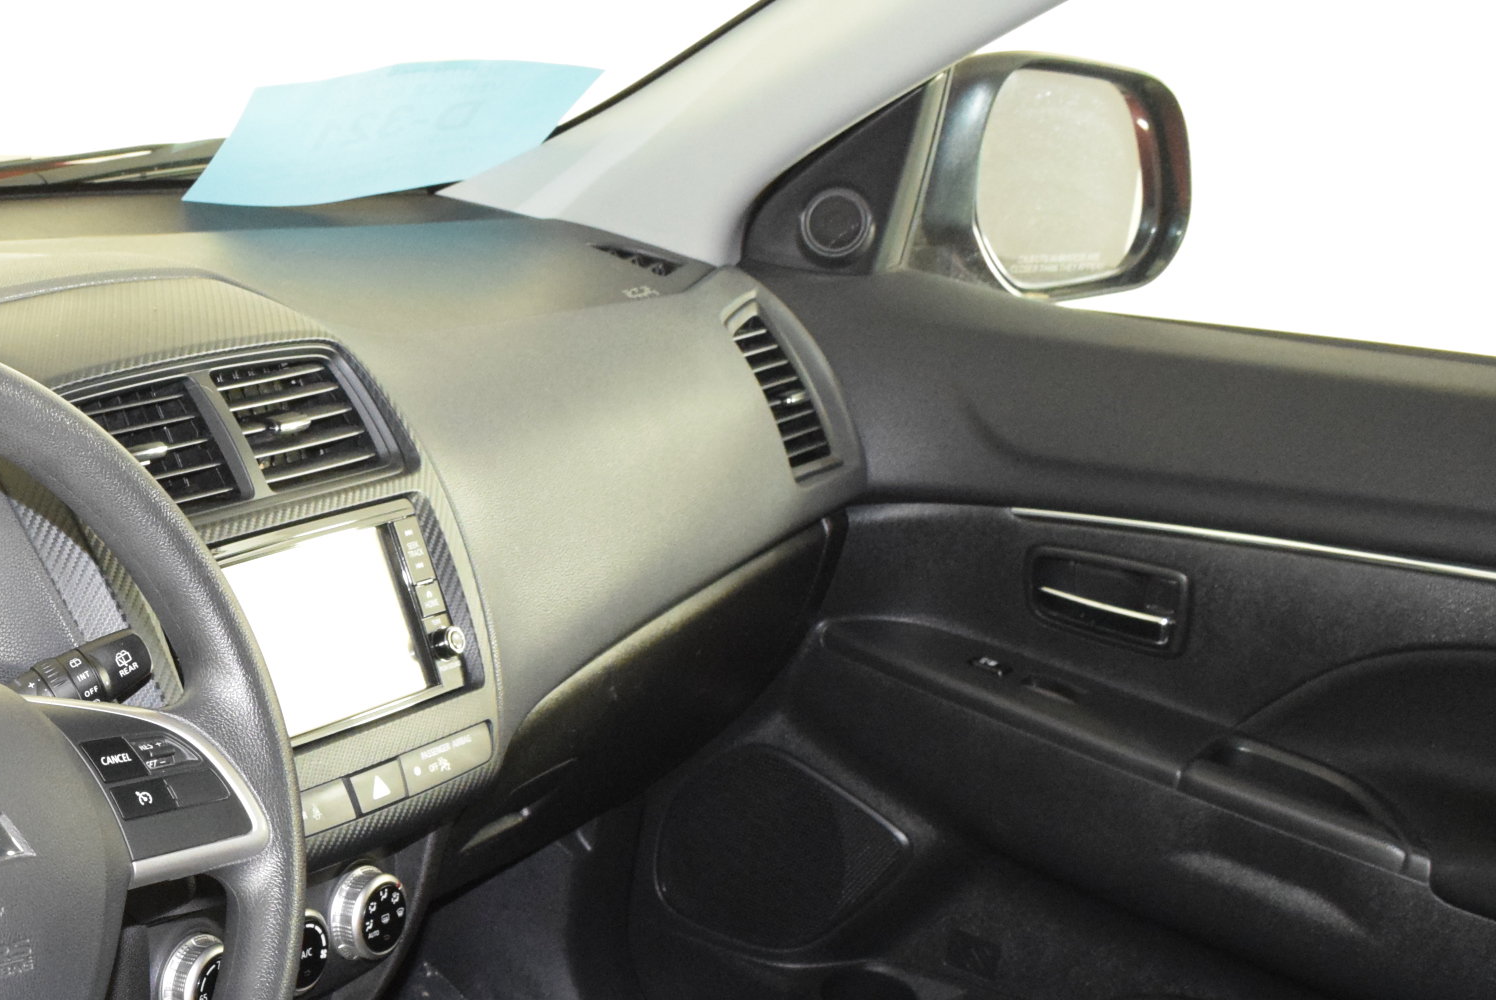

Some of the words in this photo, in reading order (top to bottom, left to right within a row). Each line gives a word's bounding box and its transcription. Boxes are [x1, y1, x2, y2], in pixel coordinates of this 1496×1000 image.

[118, 661, 139, 678] REAR
[76, 670, 91, 683] INT
[84, 685, 99, 698] OFF
[100, 752, 133, 766] CANCEL
[301, 947, 313, 959] A/C
